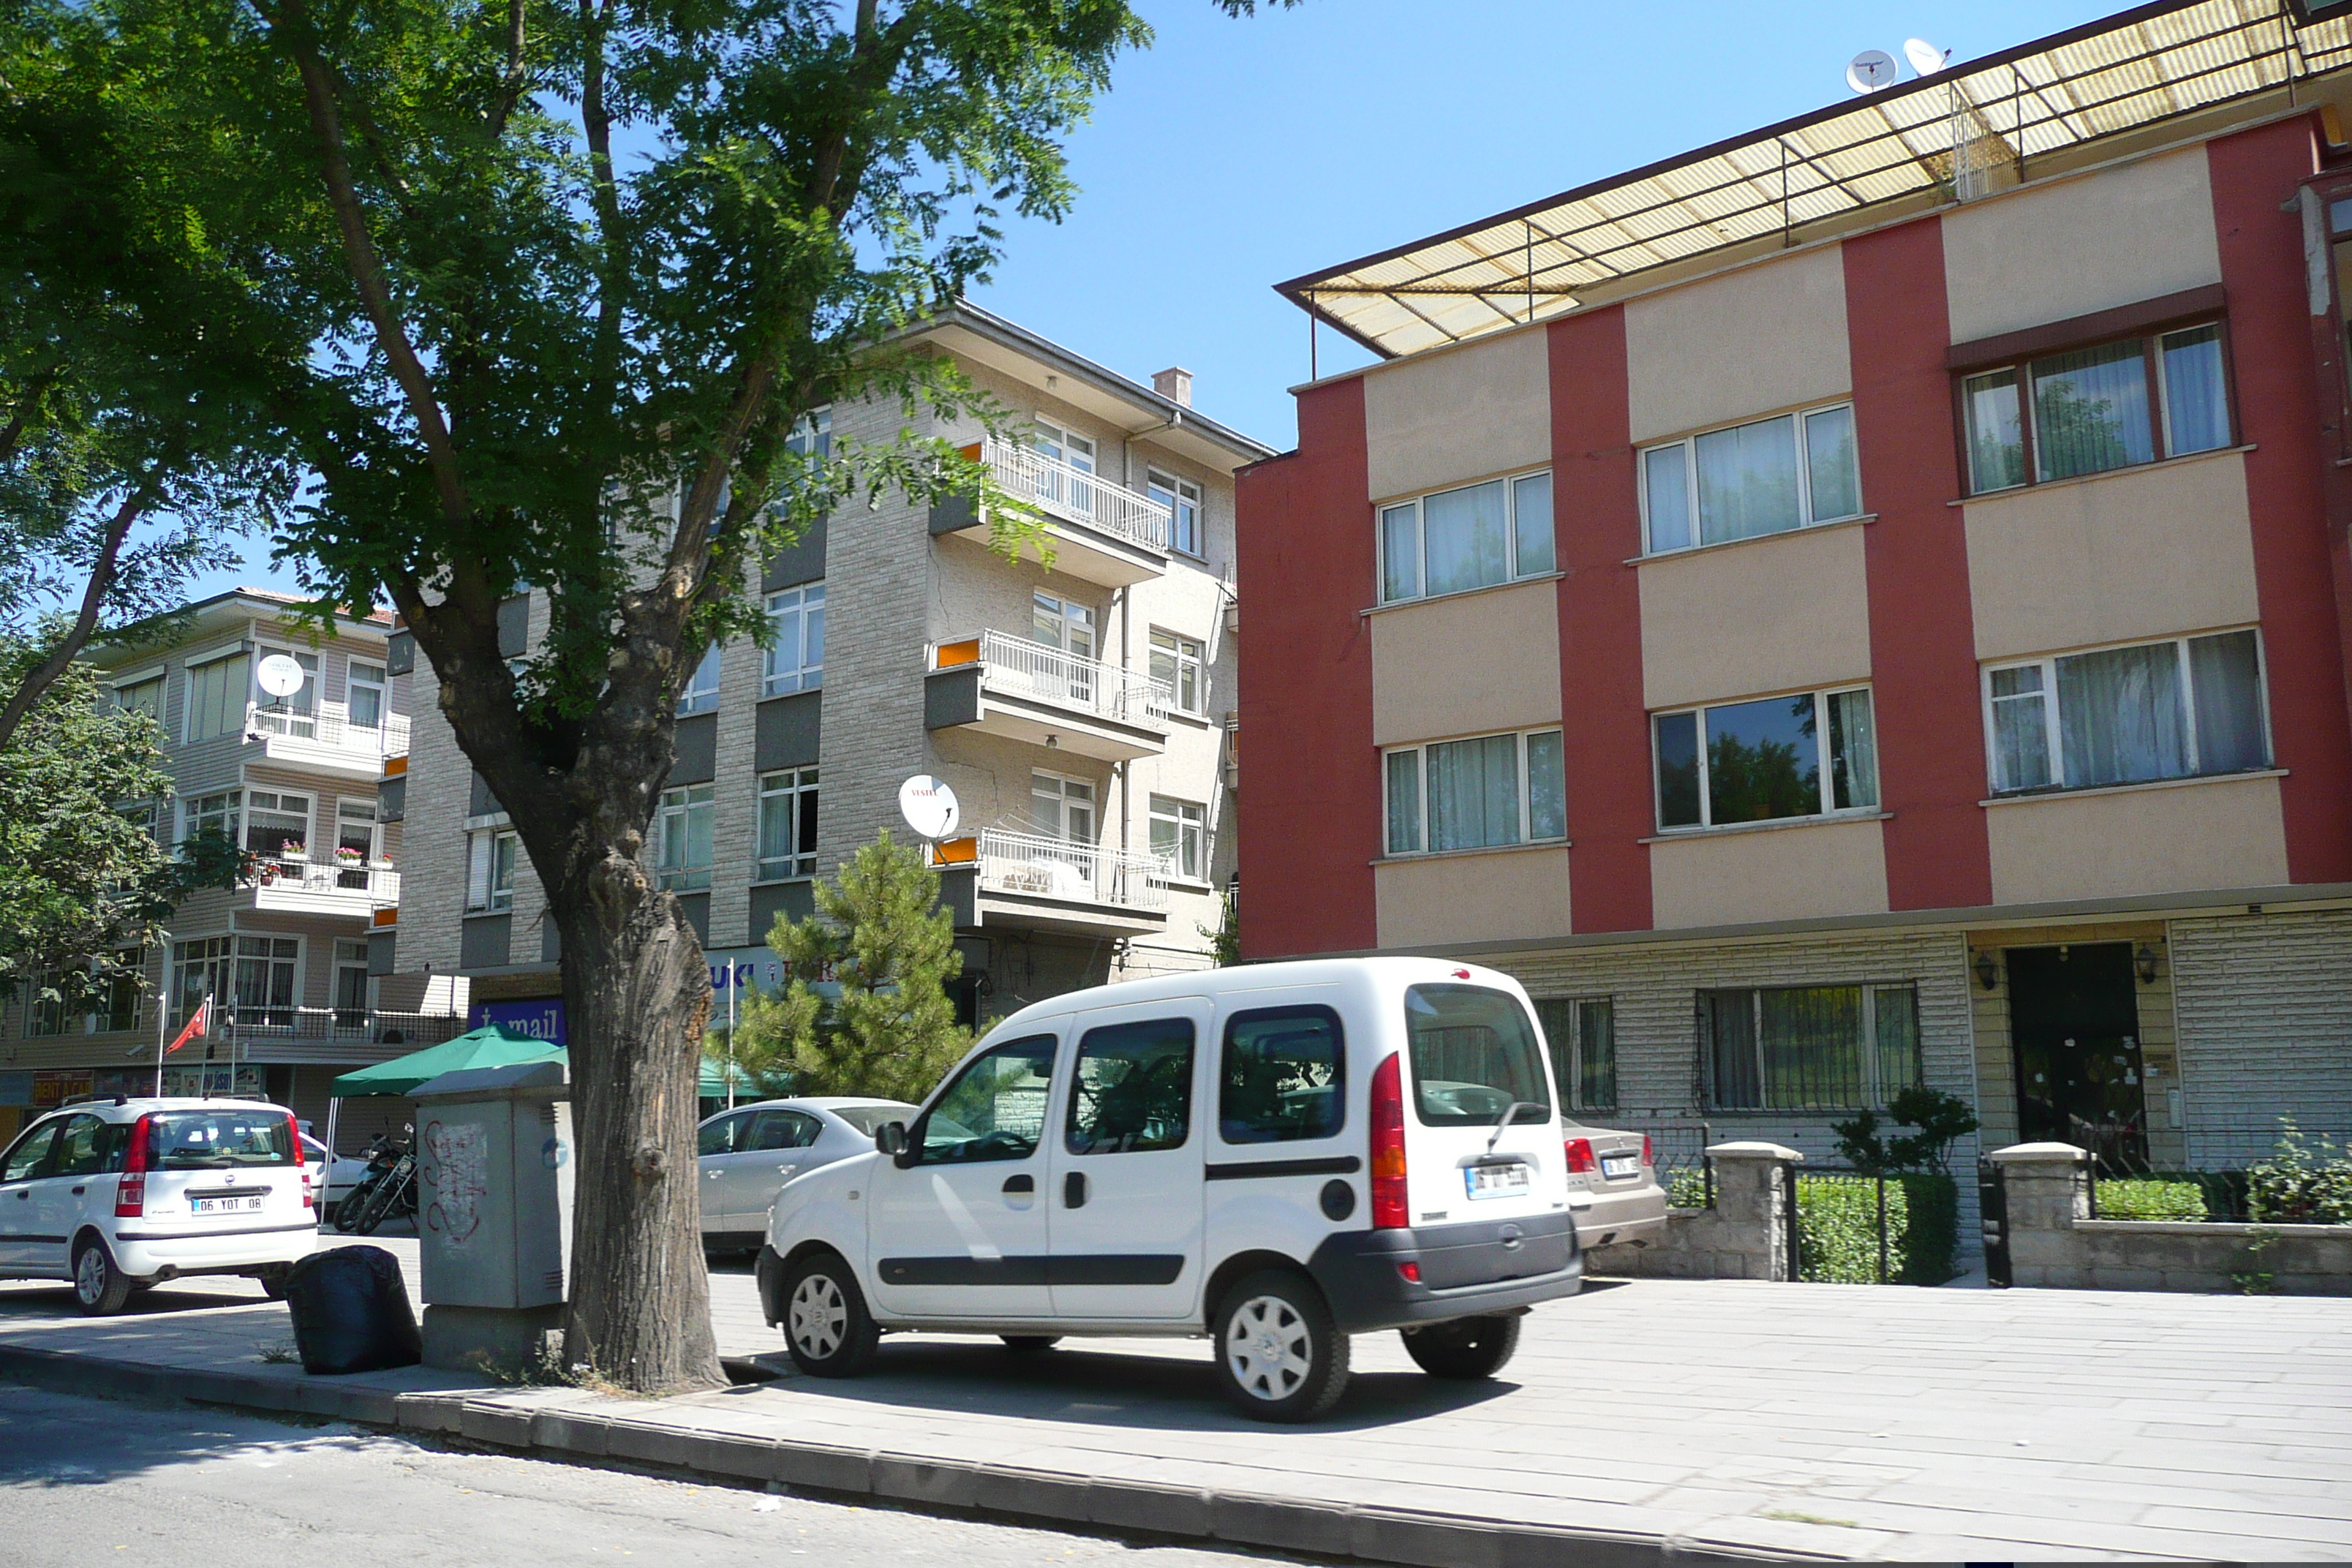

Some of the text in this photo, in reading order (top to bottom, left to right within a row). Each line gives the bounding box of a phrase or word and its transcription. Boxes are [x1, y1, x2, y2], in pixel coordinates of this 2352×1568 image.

[481, 1007, 557, 1039] İmail
[201, 1198, 261, 1211] 06 YOT 08
